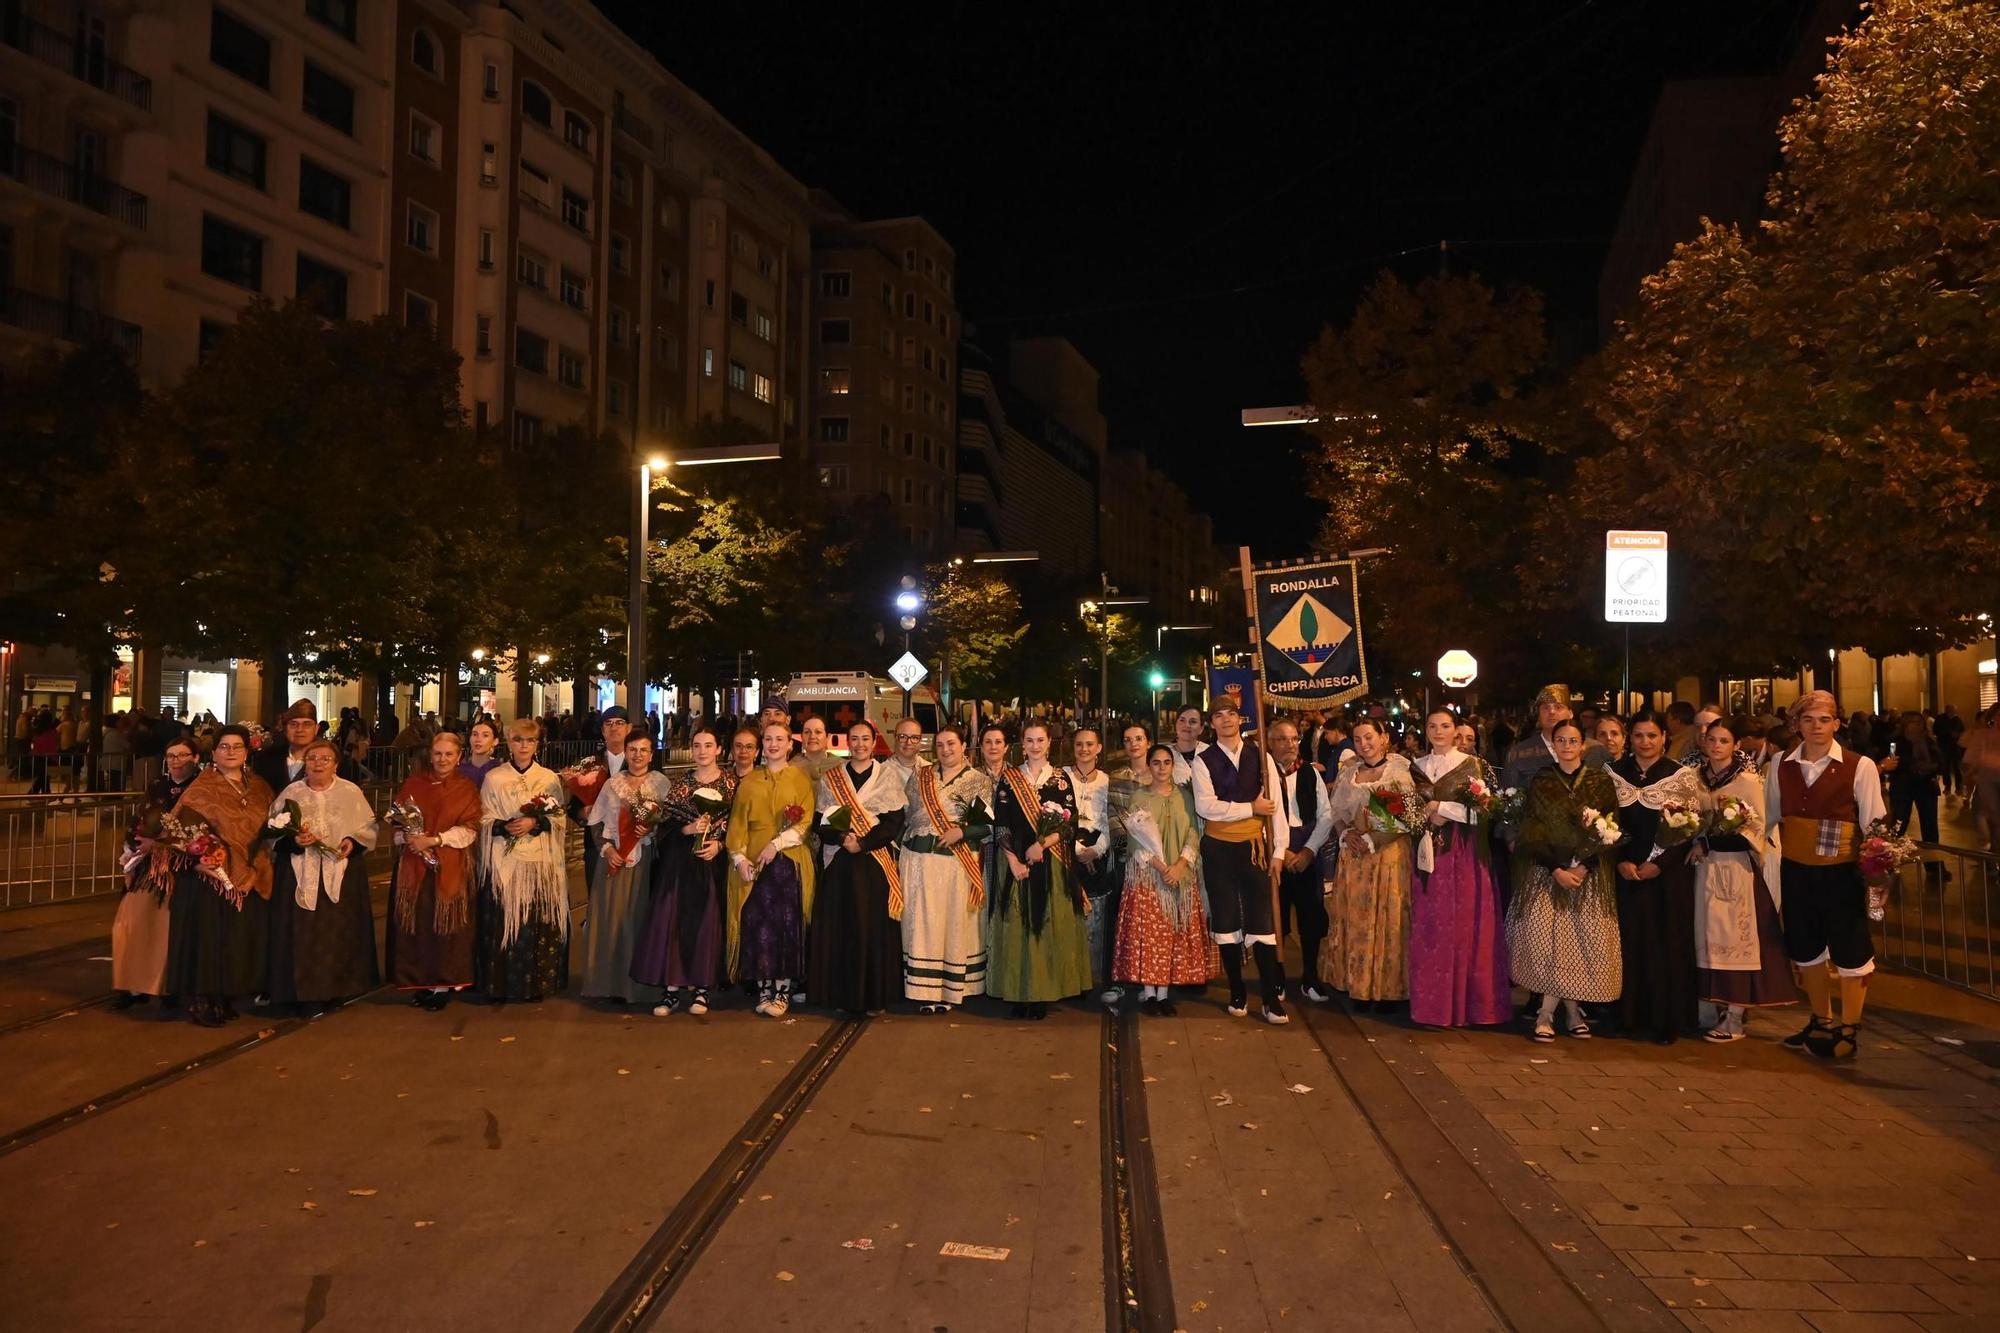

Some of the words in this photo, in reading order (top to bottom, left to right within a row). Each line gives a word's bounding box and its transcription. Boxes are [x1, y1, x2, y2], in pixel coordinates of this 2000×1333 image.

[1270, 576, 1340, 593] RONDALLA
[1612, 598, 1660, 606] PRIORIDAD
[900, 664, 917, 678] 30
[1268, 674, 1359, 692] CHIPRANESCA
[797, 686, 858, 695] AMBULANCIA
